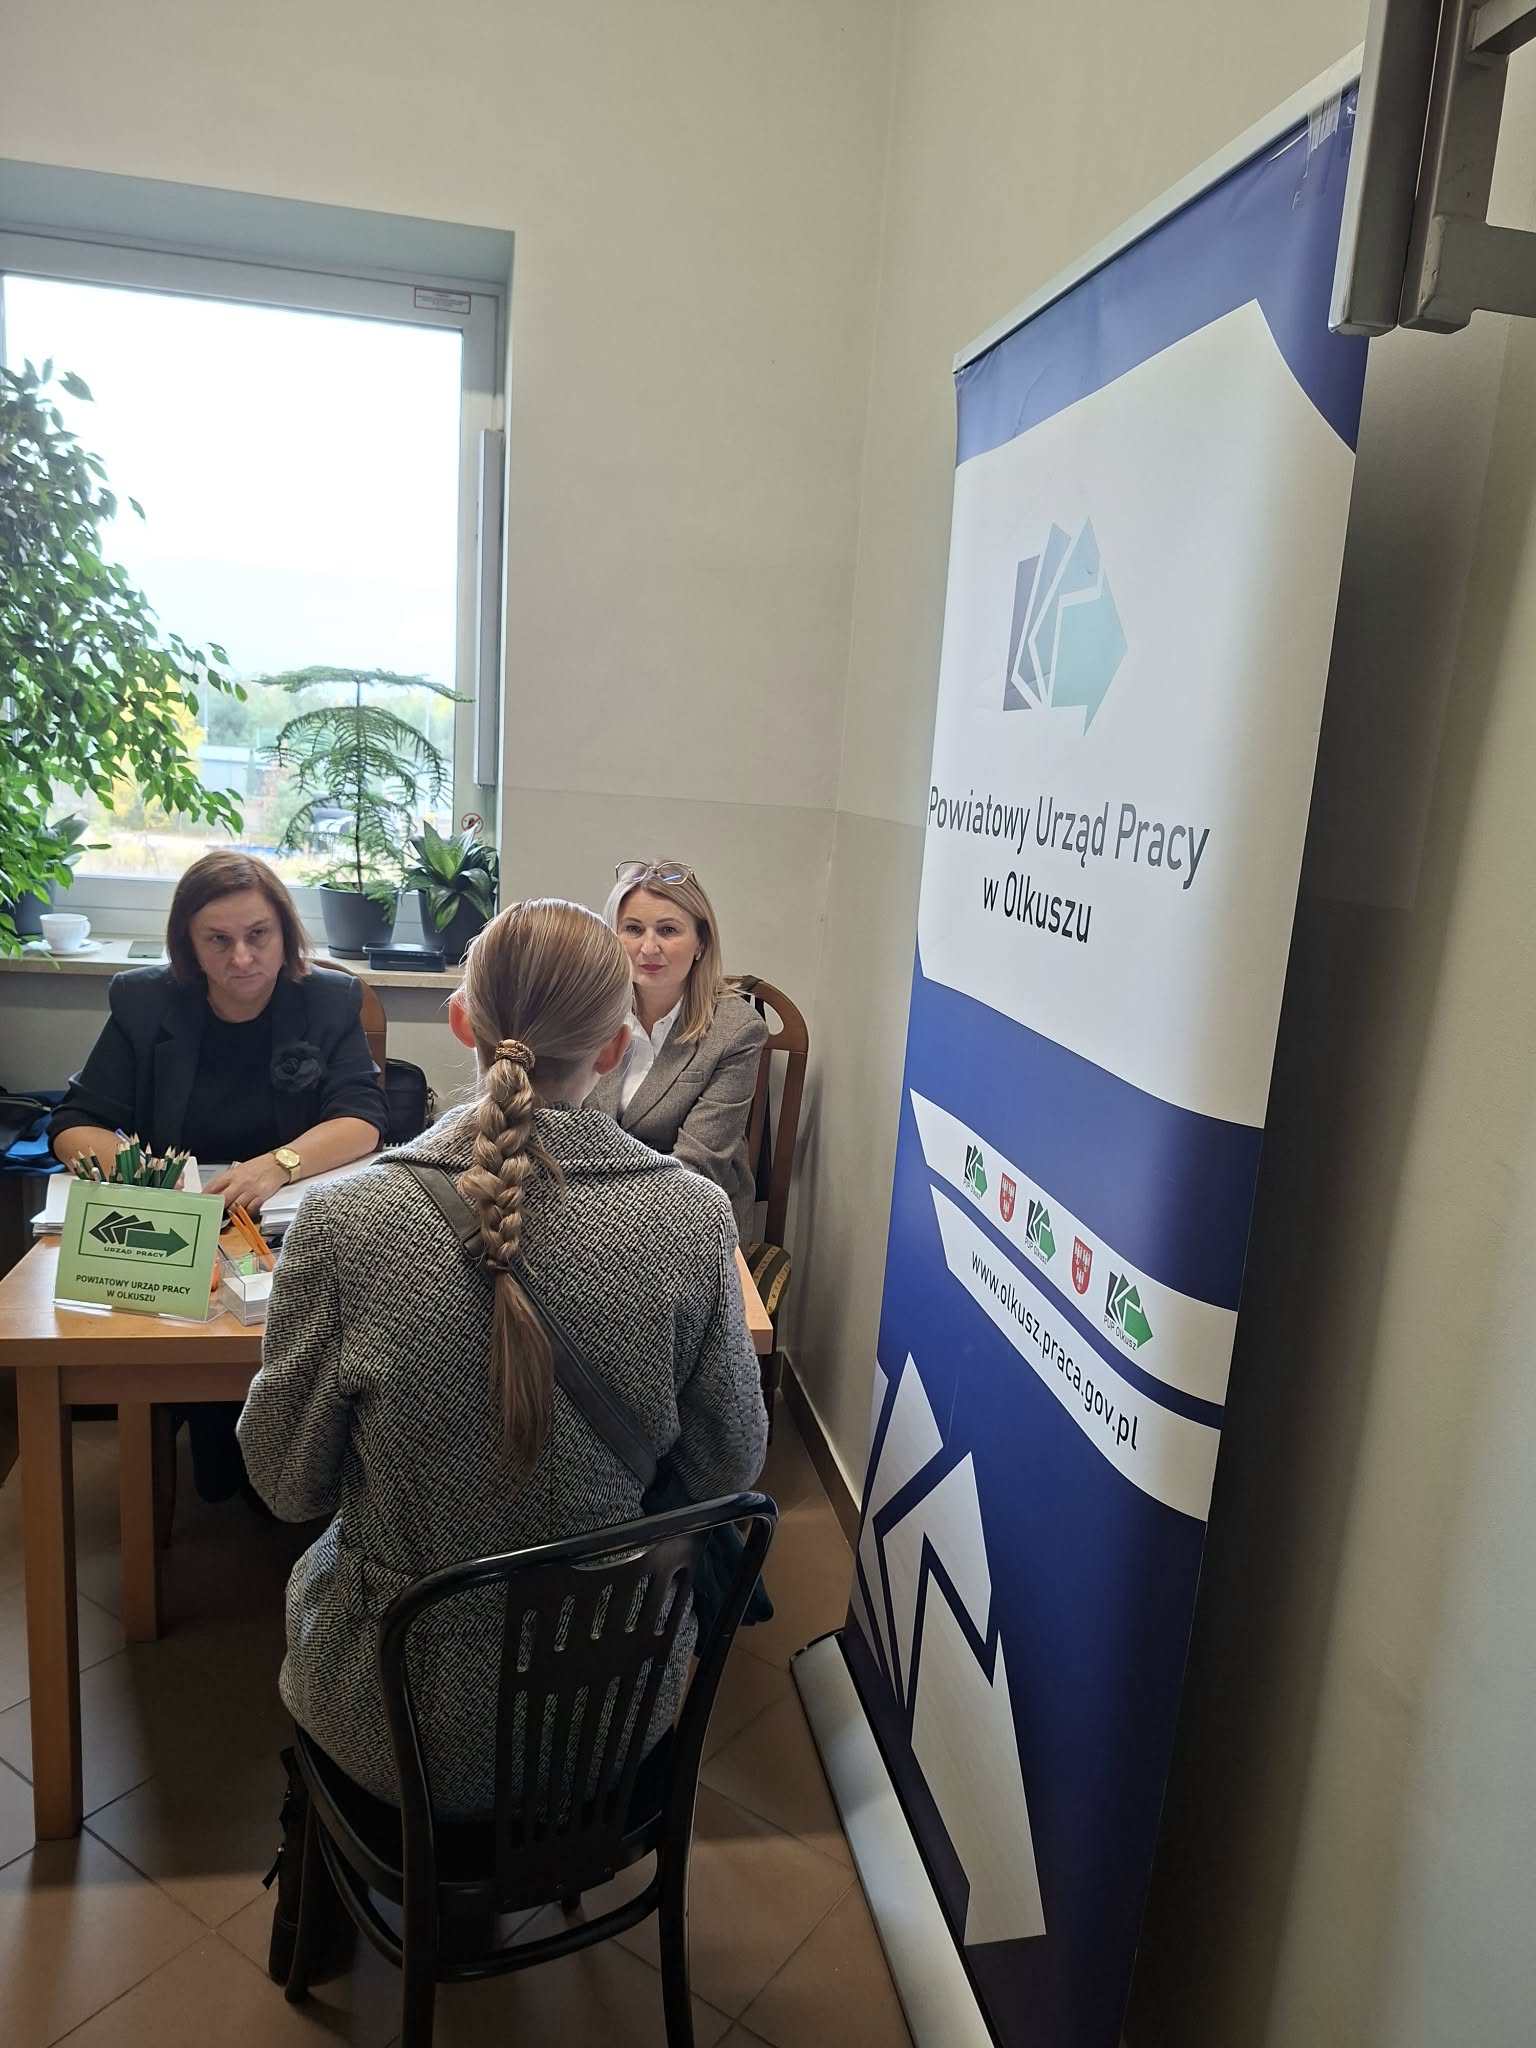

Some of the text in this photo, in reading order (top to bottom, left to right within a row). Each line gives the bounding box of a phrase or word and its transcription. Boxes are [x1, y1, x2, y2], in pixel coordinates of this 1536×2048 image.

[928, 785, 1211, 890] Powiatowy Urząd Pracy
[983, 870, 1092, 944] w Olkuszu
[136, 1250, 164, 1258] PRACY
[76, 1274, 191, 1295] POWIATOWY URZĄD PRACY
[106, 1289, 156, 1302] W OLKUSZU
[971, 1250, 1139, 1451] www.olkusz.praca.gov.pl
[1103, 1315, 1137, 1352] PUP Olkusz
